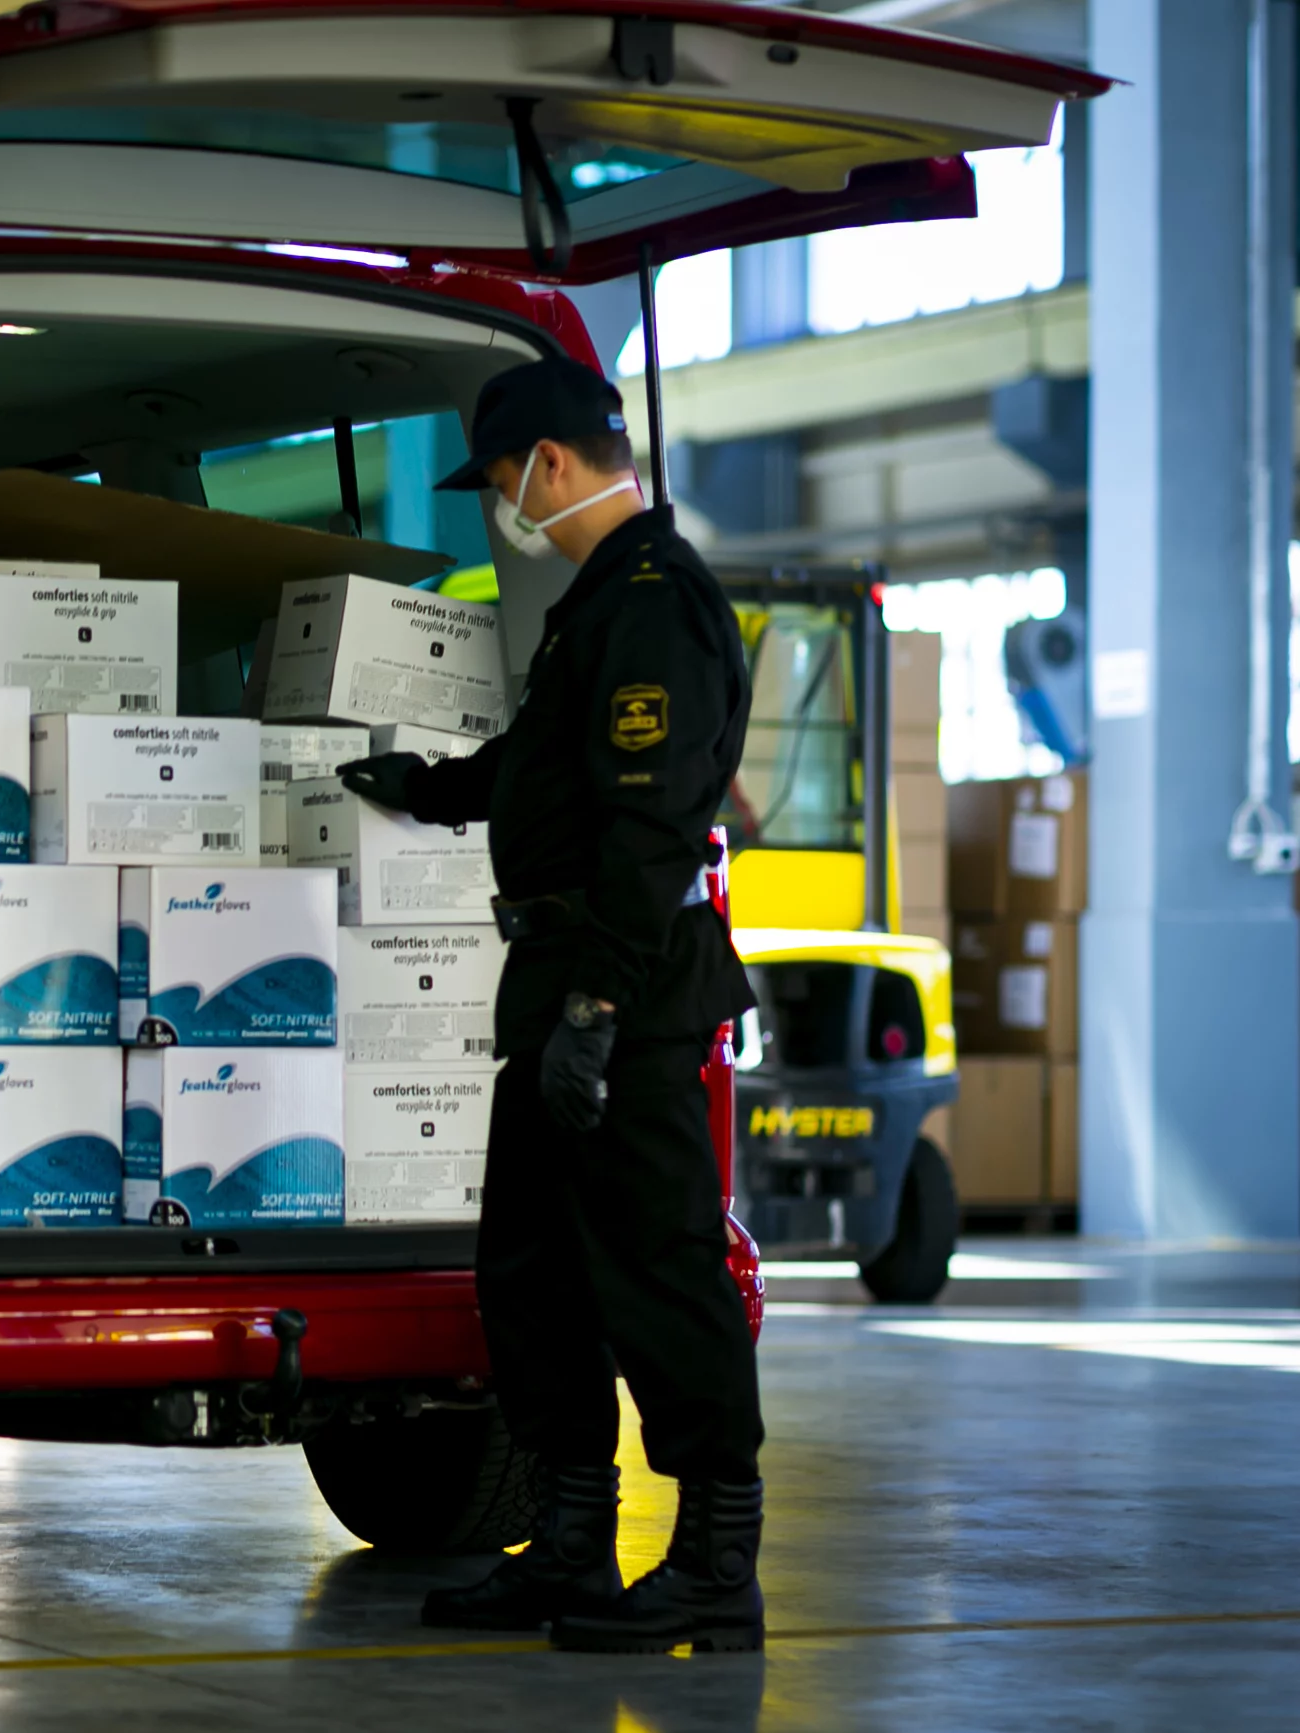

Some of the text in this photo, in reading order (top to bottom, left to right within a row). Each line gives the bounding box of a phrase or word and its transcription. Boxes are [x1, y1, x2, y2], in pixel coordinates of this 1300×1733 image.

[32, 588, 138, 605] comforties soft nitrile
[54, 606, 116, 620] easyglide & grip
[391, 598, 495, 630] comforties soft nitrile
[410, 617, 471, 640] easyglide & grip
[113, 726, 220, 741] comforties soft nitrile
[135, 744, 198, 758] easyglide & grip
[166, 897, 251, 913] feathergloves
[371, 935, 480, 950] comforties soft nitrile
[394, 952, 457, 966] easyglide & grip
[28, 1010, 113, 1025] SOFT-NITRILE
[250, 1013, 332, 1027] SOFT-NITRILE
[179, 1077, 261, 1094] feathergloves
[373, 1082, 482, 1097] comforties soft nitrile
[395, 1099, 459, 1113] easyglide & grip
[750, 1106, 873, 1137] HYSTER
[32, 1191, 116, 1206] SOFT-NITRILE
[261, 1193, 341, 1207] SOFT-NITRILE
